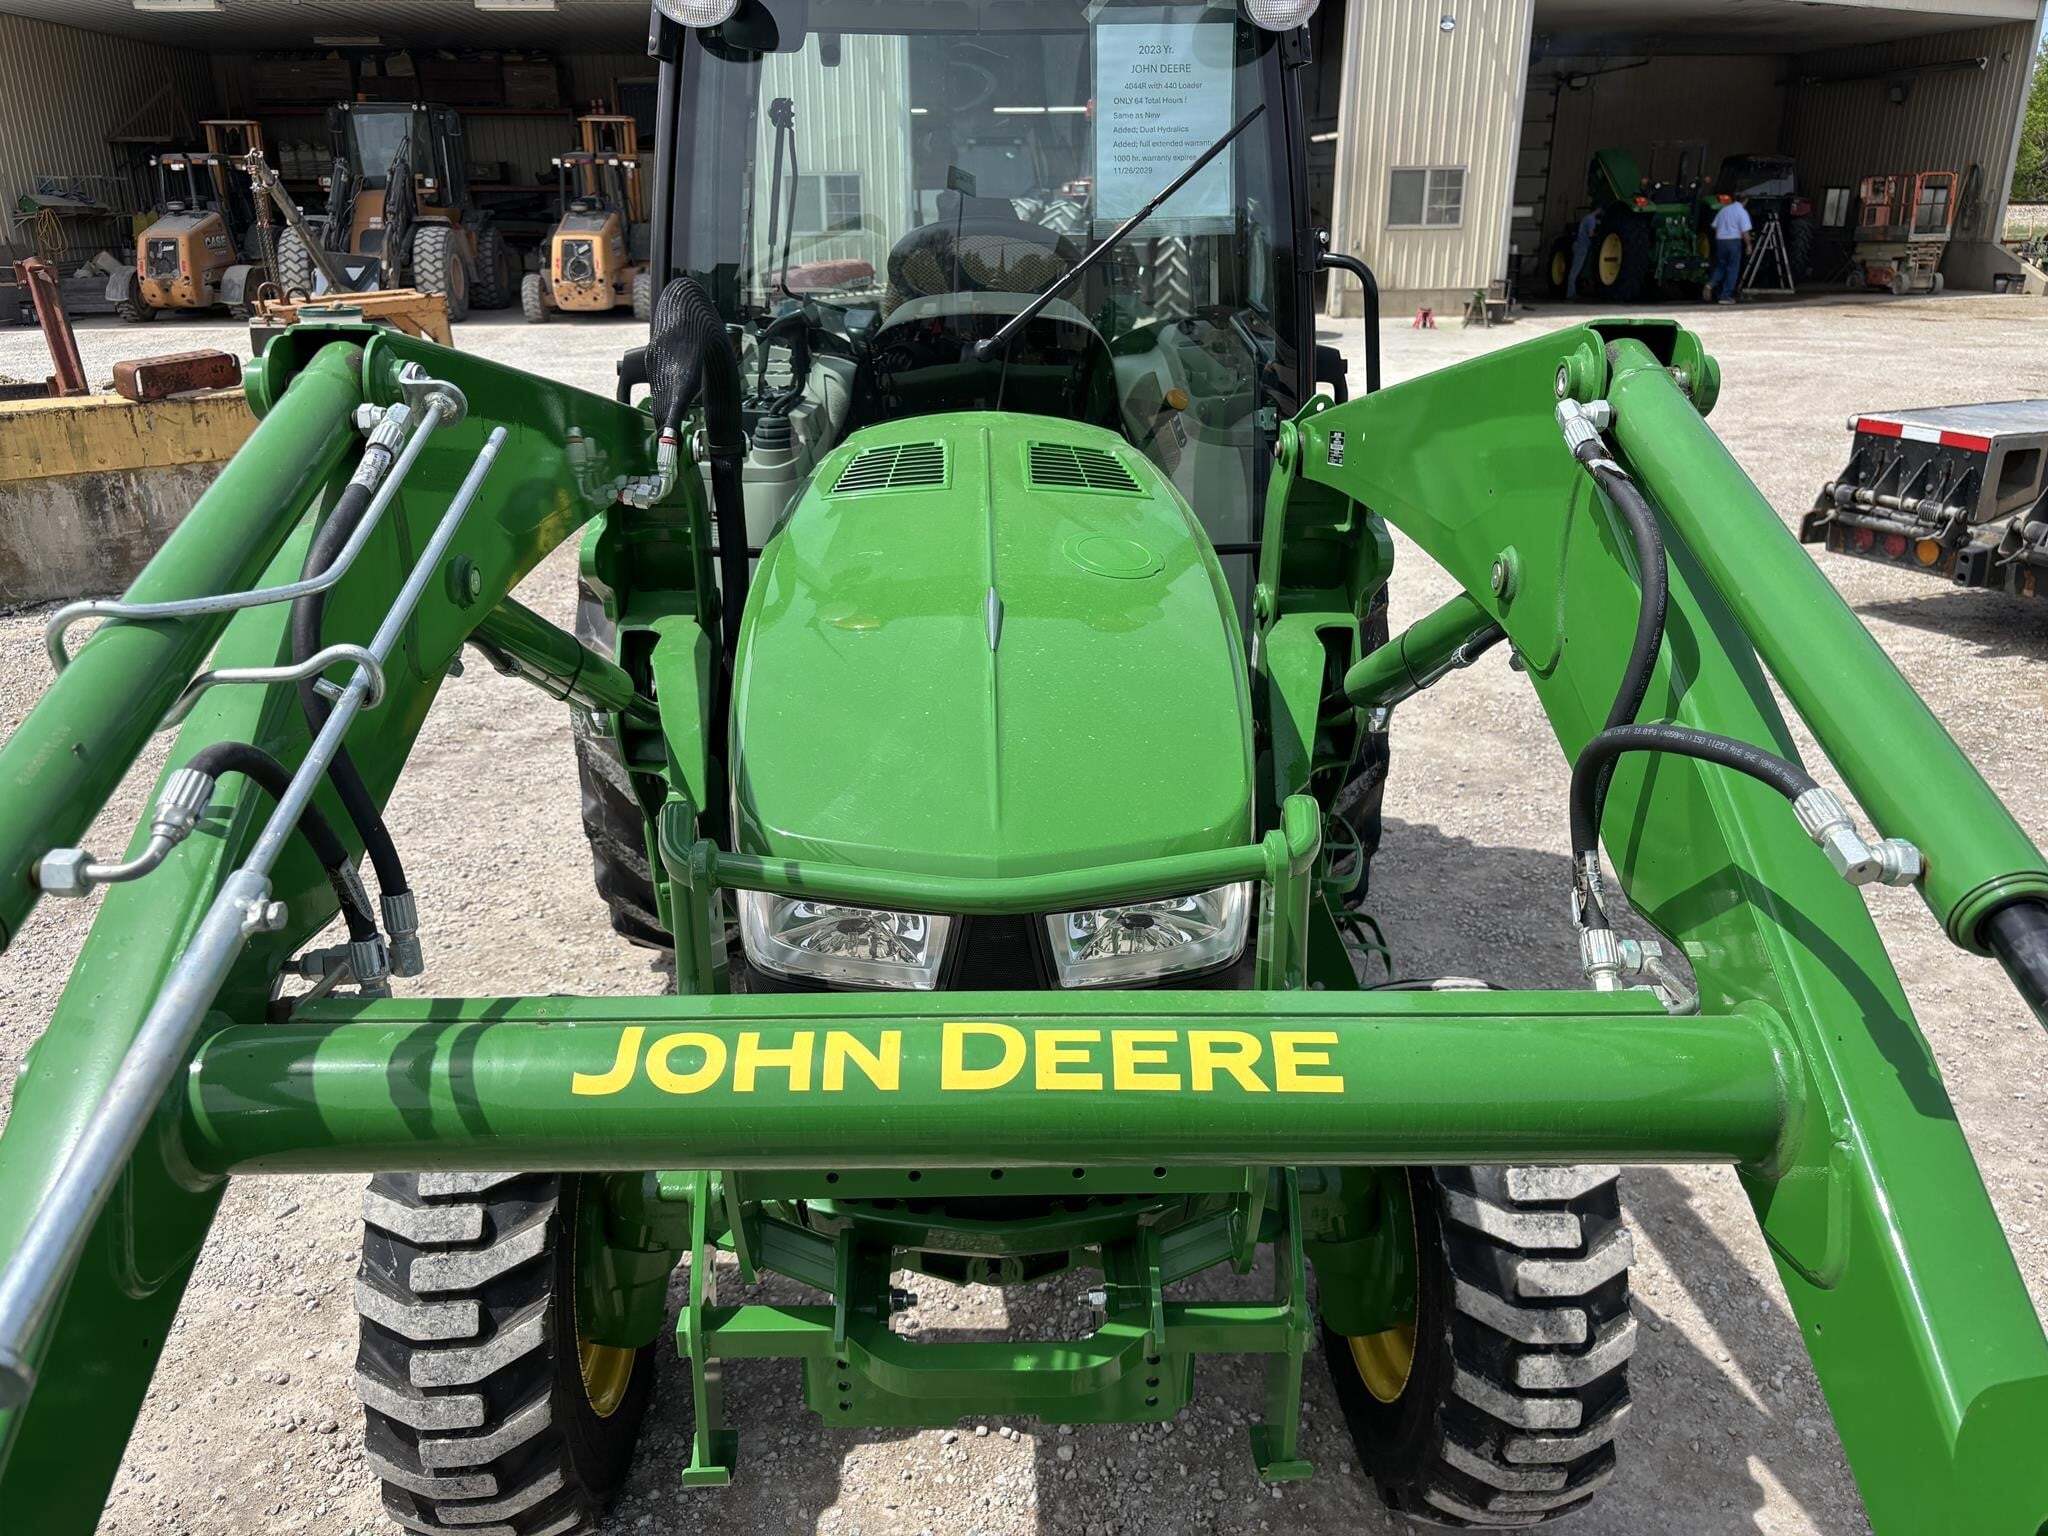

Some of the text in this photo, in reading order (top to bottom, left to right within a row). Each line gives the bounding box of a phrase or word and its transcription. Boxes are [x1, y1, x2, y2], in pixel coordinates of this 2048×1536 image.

[1139, 45, 1175, 55] 2023 Yr.
[1131, 64, 1191, 73] JOHN DEERE
[1178, 81, 1203, 89] Loader
[1114, 97, 1133, 105] ONLY
[1145, 96, 1161, 104] Total
[1162, 96, 1183, 104] Hours
[1157, 126, 1189, 134] Hydralics
[1184, 139, 1214, 147] warranty
[1114, 154, 1130, 162] 1000
[1131, 154, 1141, 162] hr.
[205, 235, 227, 249] CASE
[571, 1022, 1344, 1095] JOHN DEERE
